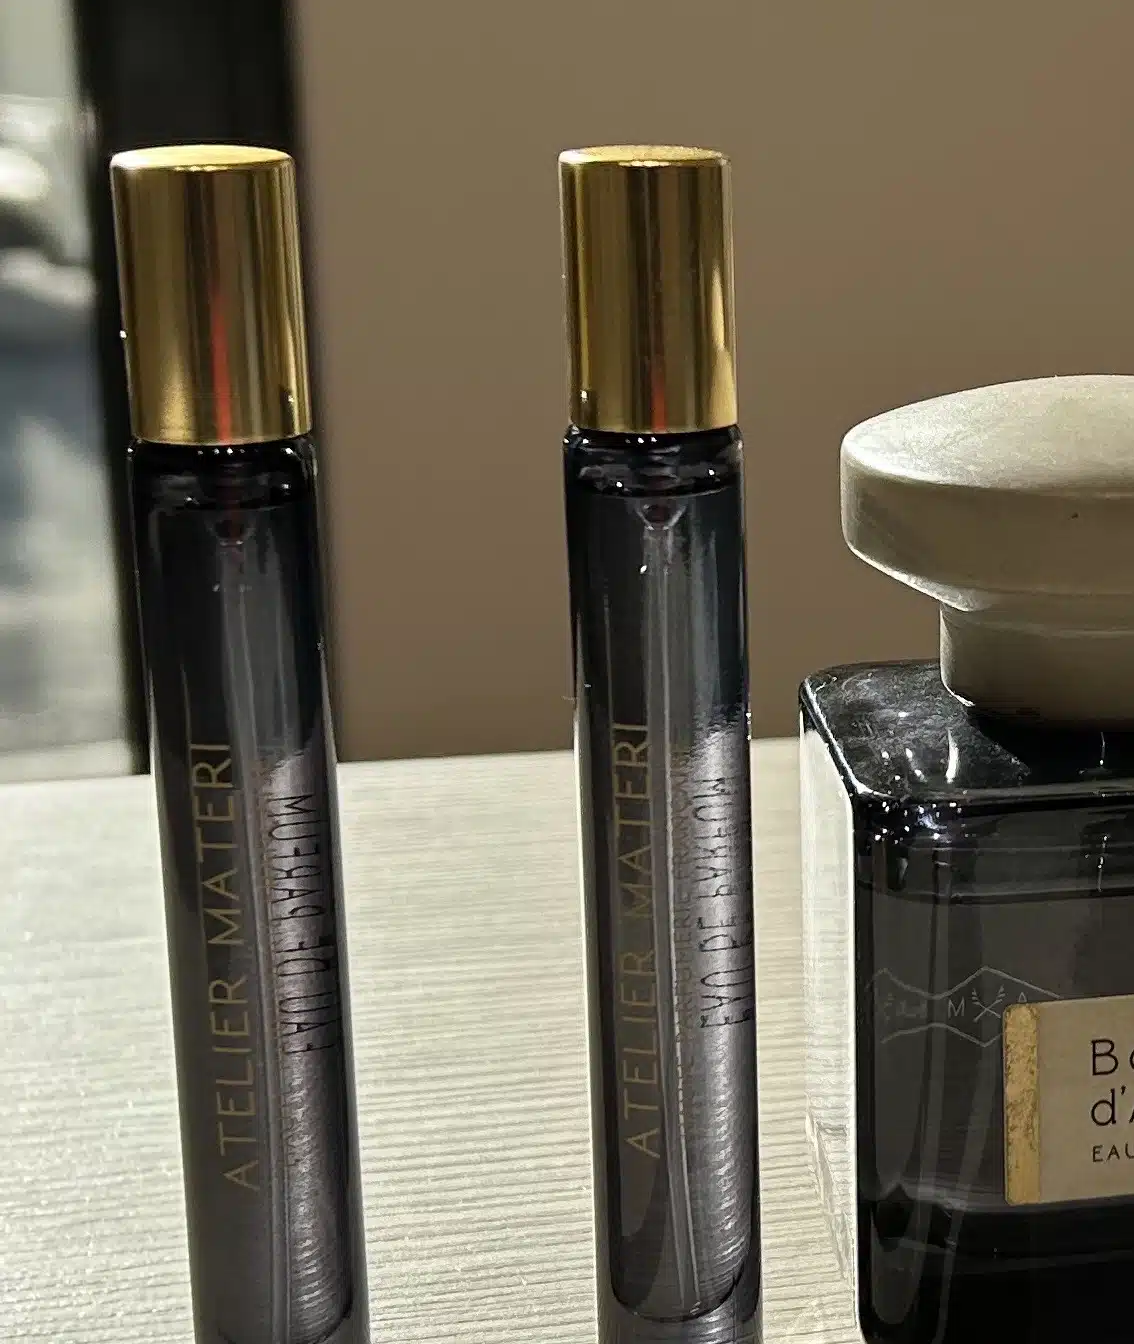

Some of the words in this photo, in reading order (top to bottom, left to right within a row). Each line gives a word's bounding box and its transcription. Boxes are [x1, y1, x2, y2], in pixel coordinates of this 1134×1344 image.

[189, 742, 246, 946] MATERI
[612, 723, 655, 919] MATERI
[208, 974, 260, 1191] ATELIER
[620, 950, 661, 1159] ATELIER
